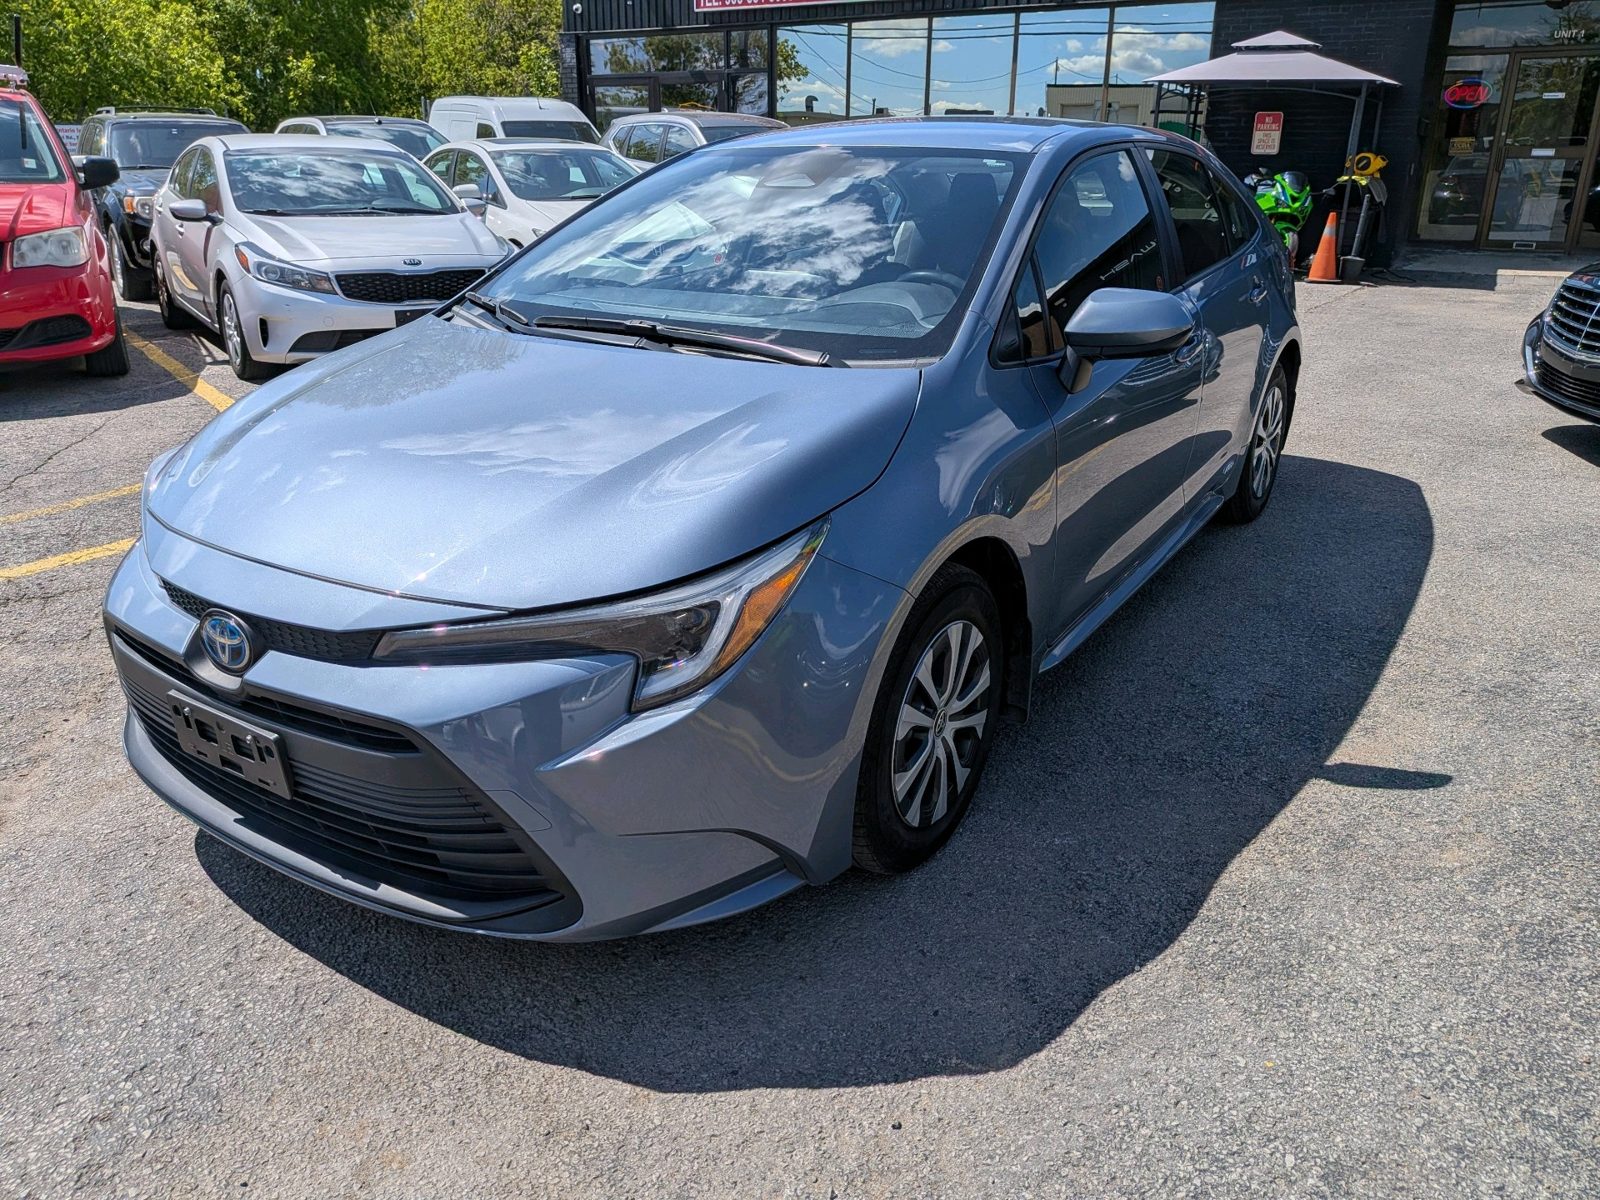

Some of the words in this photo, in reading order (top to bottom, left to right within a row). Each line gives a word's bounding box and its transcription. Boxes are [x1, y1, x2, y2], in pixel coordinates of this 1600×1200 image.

[1554, 29, 1578, 39] UNIT
[1448, 86, 1489, 102] OPEN
[1265, 116, 1273, 124] NO
[1256, 123, 1280, 131] PARKING
